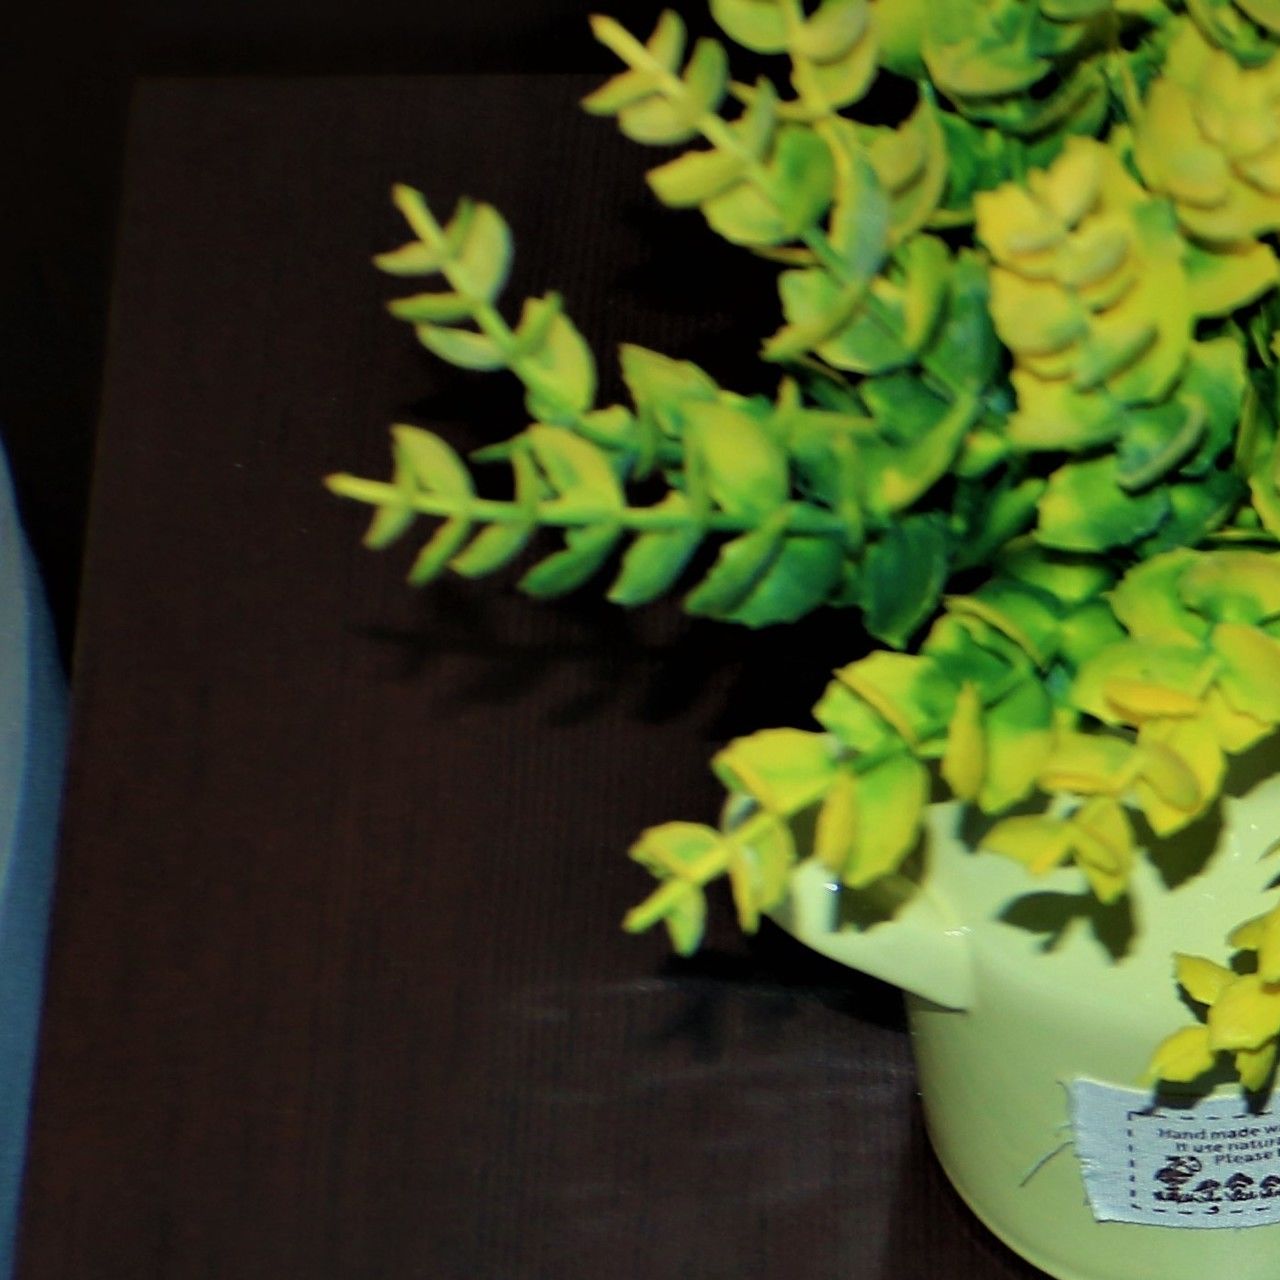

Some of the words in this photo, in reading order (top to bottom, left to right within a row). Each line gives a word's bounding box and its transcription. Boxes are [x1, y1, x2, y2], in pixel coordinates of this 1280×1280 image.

[1210, 1126, 1260, 1140] made
[1192, 1142, 1223, 1154] use
[1214, 1150, 1273, 1164] Please
